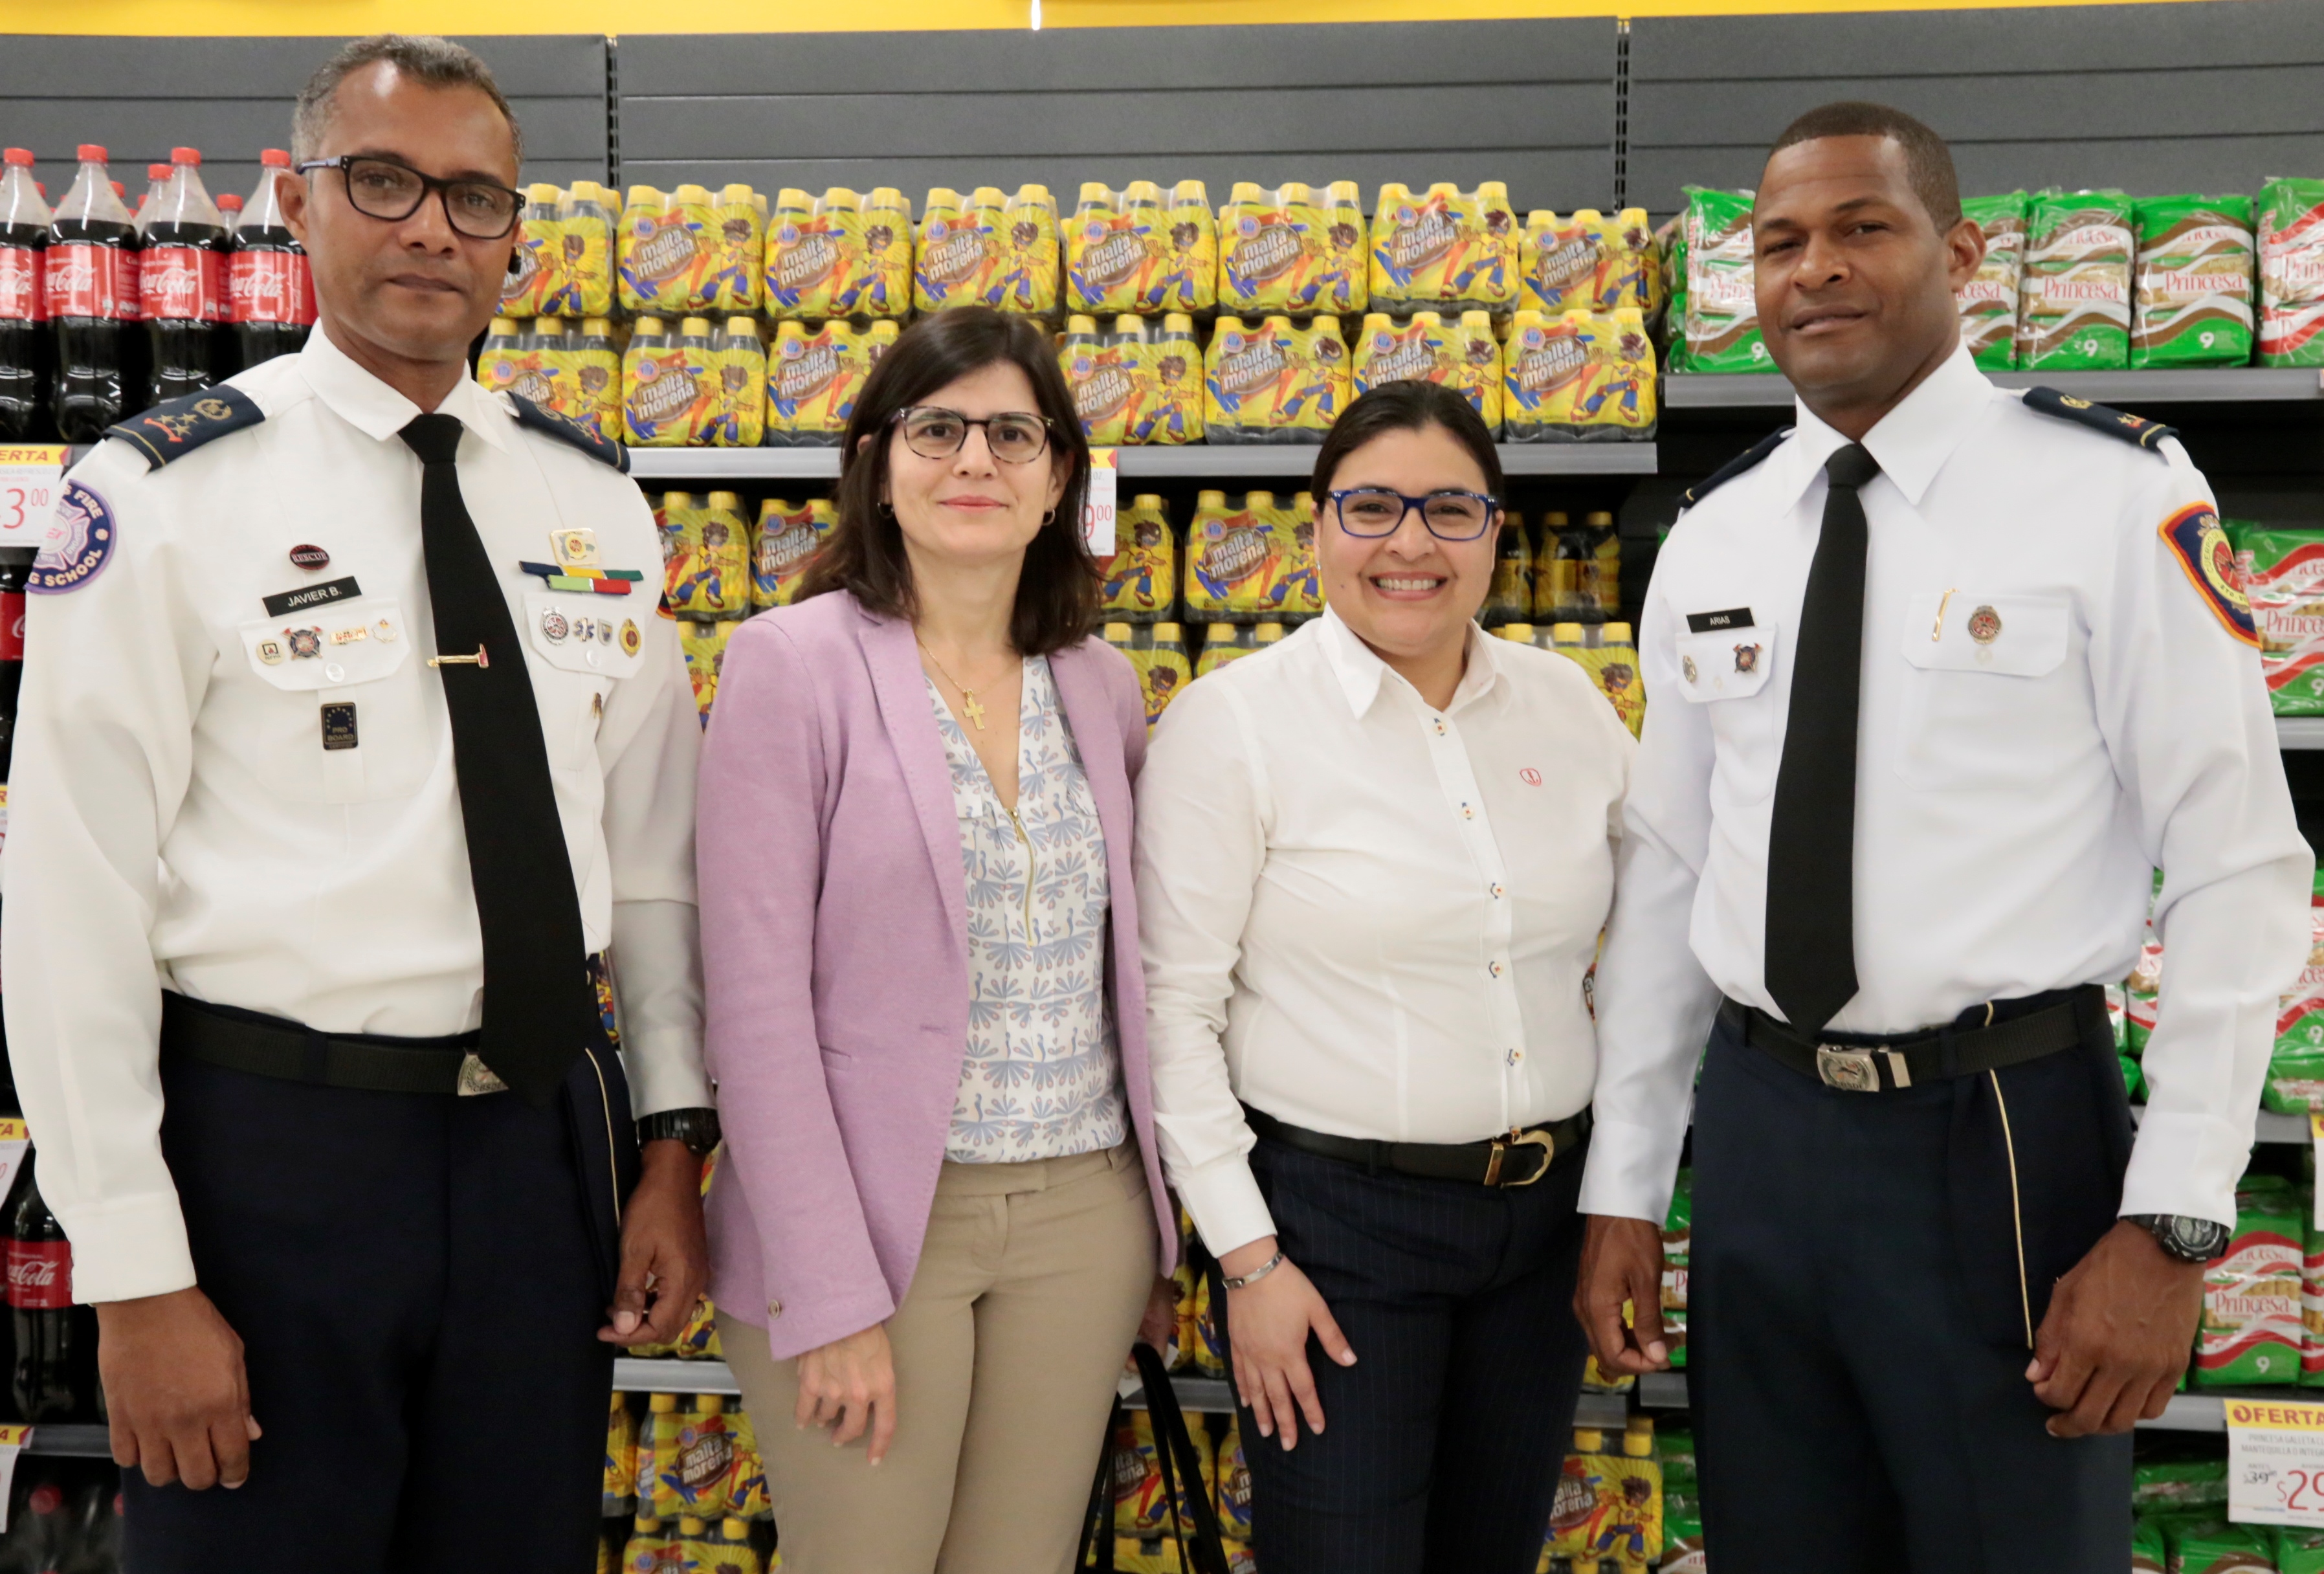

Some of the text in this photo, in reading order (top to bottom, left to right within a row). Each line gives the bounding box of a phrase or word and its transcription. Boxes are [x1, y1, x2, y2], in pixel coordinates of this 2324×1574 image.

[641, 230, 682, 261] malta
[1244, 230, 1287, 260] malta
[1396, 225, 1454, 263] morena
[1401, 216, 1444, 247] malta
[637, 238, 694, 278] morena
[784, 238, 825, 269] malta
[929, 242, 984, 281] morena
[932, 234, 973, 265] malta
[1087, 243, 1143, 283] morena
[1090, 235, 1131, 266] malta
[1240, 239, 1298, 276] morena
[780, 245, 836, 286] morena
[2043, 277, 2118, 300] Princesa
[2165, 271, 2243, 292] Princesa
[1528, 340, 1574, 370] malta
[1751, 342, 1765, 361] 9
[2083, 339, 2098, 357] 9
[2199, 331, 2215, 349] 9
[785, 349, 826, 379] malta
[1223, 353, 1283, 390] morena
[1227, 345, 1273, 373] malta
[1377, 345, 1422, 375] malta
[1523, 348, 1585, 388] morena
[642, 373, 684, 403] malta
[781, 358, 836, 395] morena
[1078, 370, 1118, 401] malta
[637, 381, 695, 419] morena
[74, 489, 104, 518] FIRE
[292, 552, 327, 562] RESCUE
[1210, 541, 1266, 579] morena
[1212, 532, 1254, 562] malta
[45, 549, 102, 587] SCHOOL
[288, 586, 342, 607] JAVIER B.
[1710, 615, 1731, 626] ARIAS
[2310, 1025, 2323, 1044] 9
[2216, 1292, 2290, 1314] Princesa
[2256, 1357, 2270, 1373] 9
[685, 1438, 723, 1465] malta
[2241, 1445, 2290, 1455] MANTEQUILLA
[2248, 1434, 2284, 1443] PRINCESA
